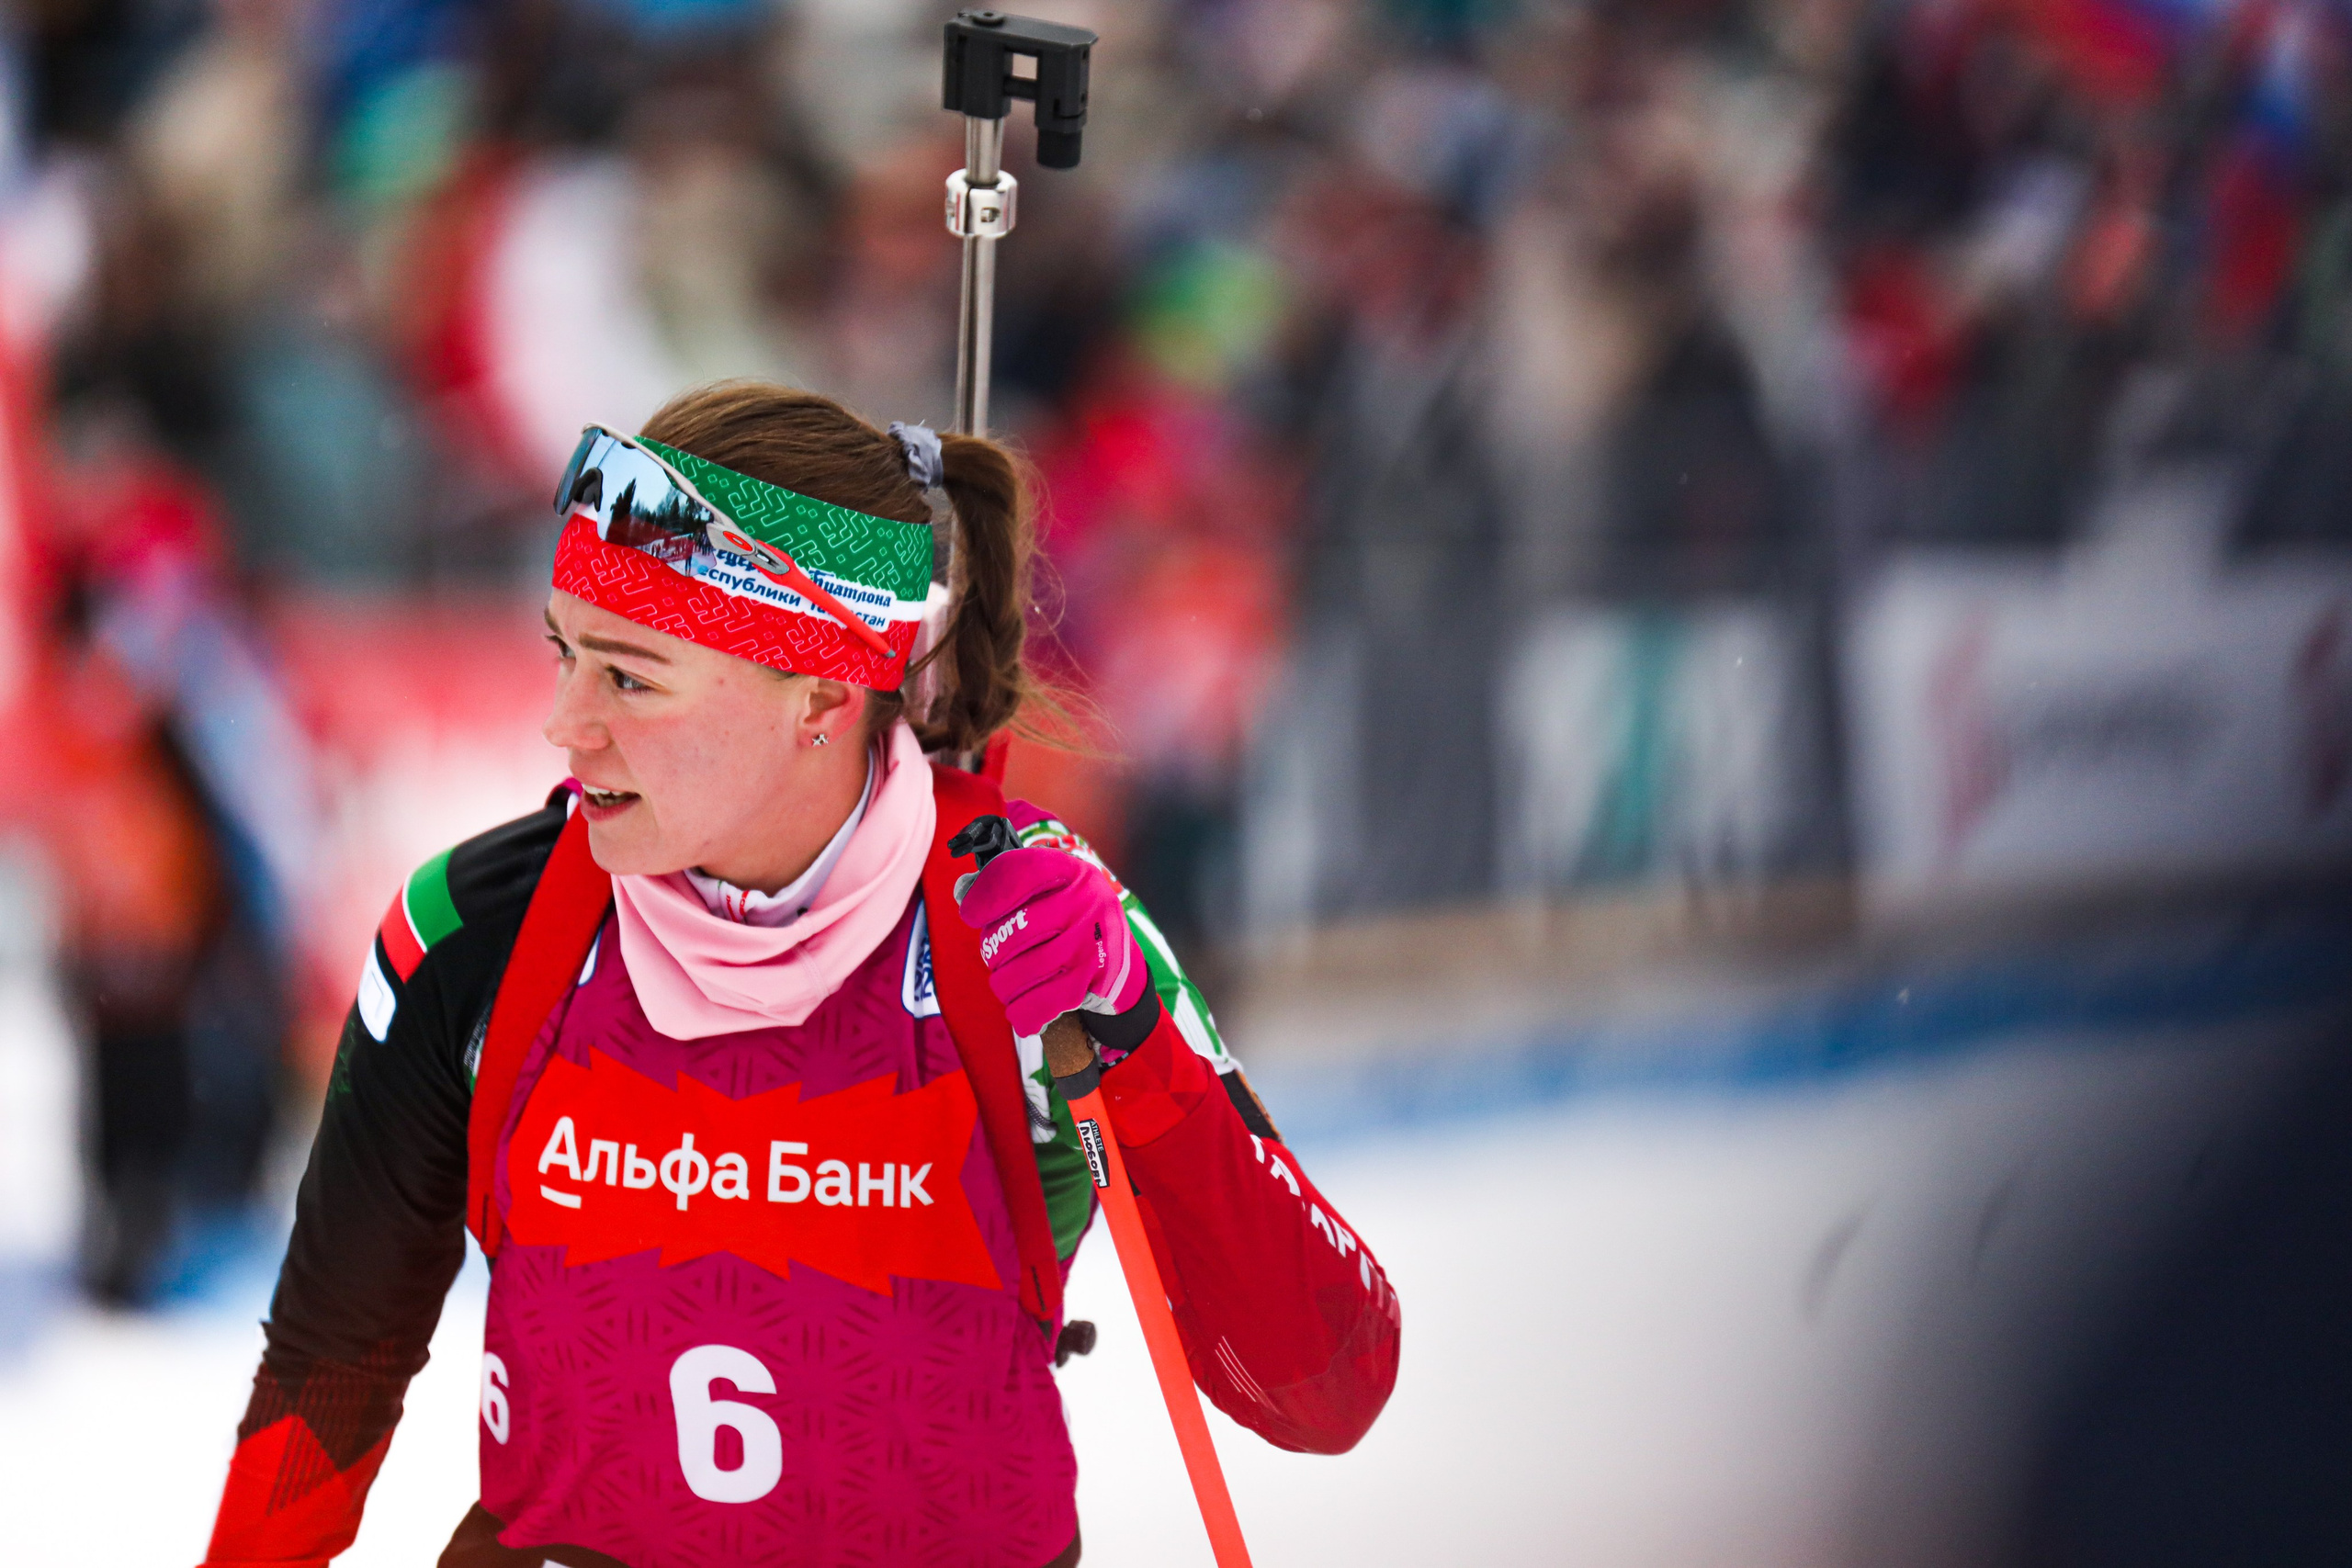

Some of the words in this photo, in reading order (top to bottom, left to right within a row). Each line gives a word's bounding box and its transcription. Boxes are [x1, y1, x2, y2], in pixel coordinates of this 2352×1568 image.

[700, 568, 801, 607] спублики
[1094, 940, 1107, 968] Legend
[537, 1115, 750, 1212] Альфа
[767, 1140, 935, 1208] Банк
[1090, 1121, 1104, 1152] ATHLETE
[481, 1350, 510, 1445] 6
[669, 1343, 783, 1504] 6
